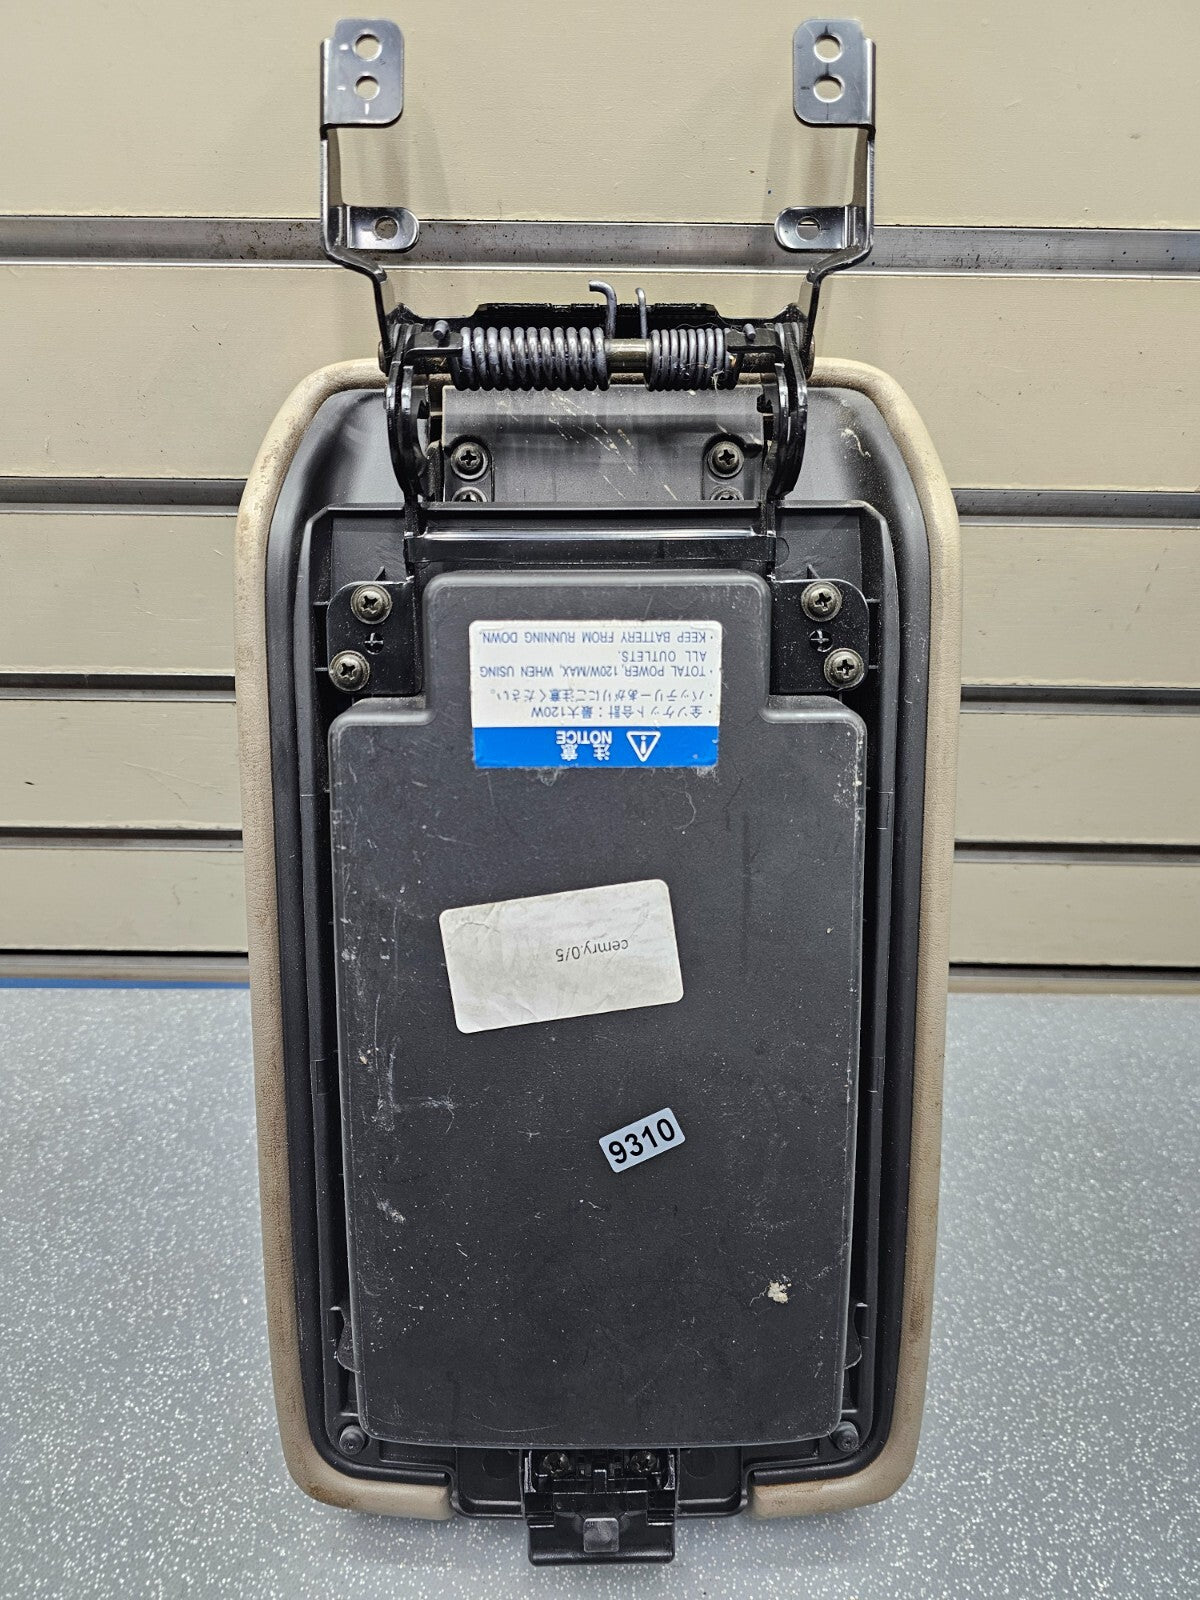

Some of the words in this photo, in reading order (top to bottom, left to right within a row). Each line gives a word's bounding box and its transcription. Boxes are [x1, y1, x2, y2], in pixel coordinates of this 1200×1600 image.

[525, 632, 575, 643] RUNNING
[582, 632, 614, 642] FROM
[621, 632, 670, 643] BATTERY
[677, 631, 706, 642] KEEP
[617, 651, 676, 662] OUTLETS.
[685, 651, 707, 662] ALL
[480, 666, 514, 677] USING
[520, 666, 553, 676] WHEN
[671, 665, 704, 676] TOTAL
[556, 730, 612, 744] NOTICE
[560, 745, 578, 761] 意
[593, 744, 610, 761] 注
[608, 1118, 675, 1164] 9310
